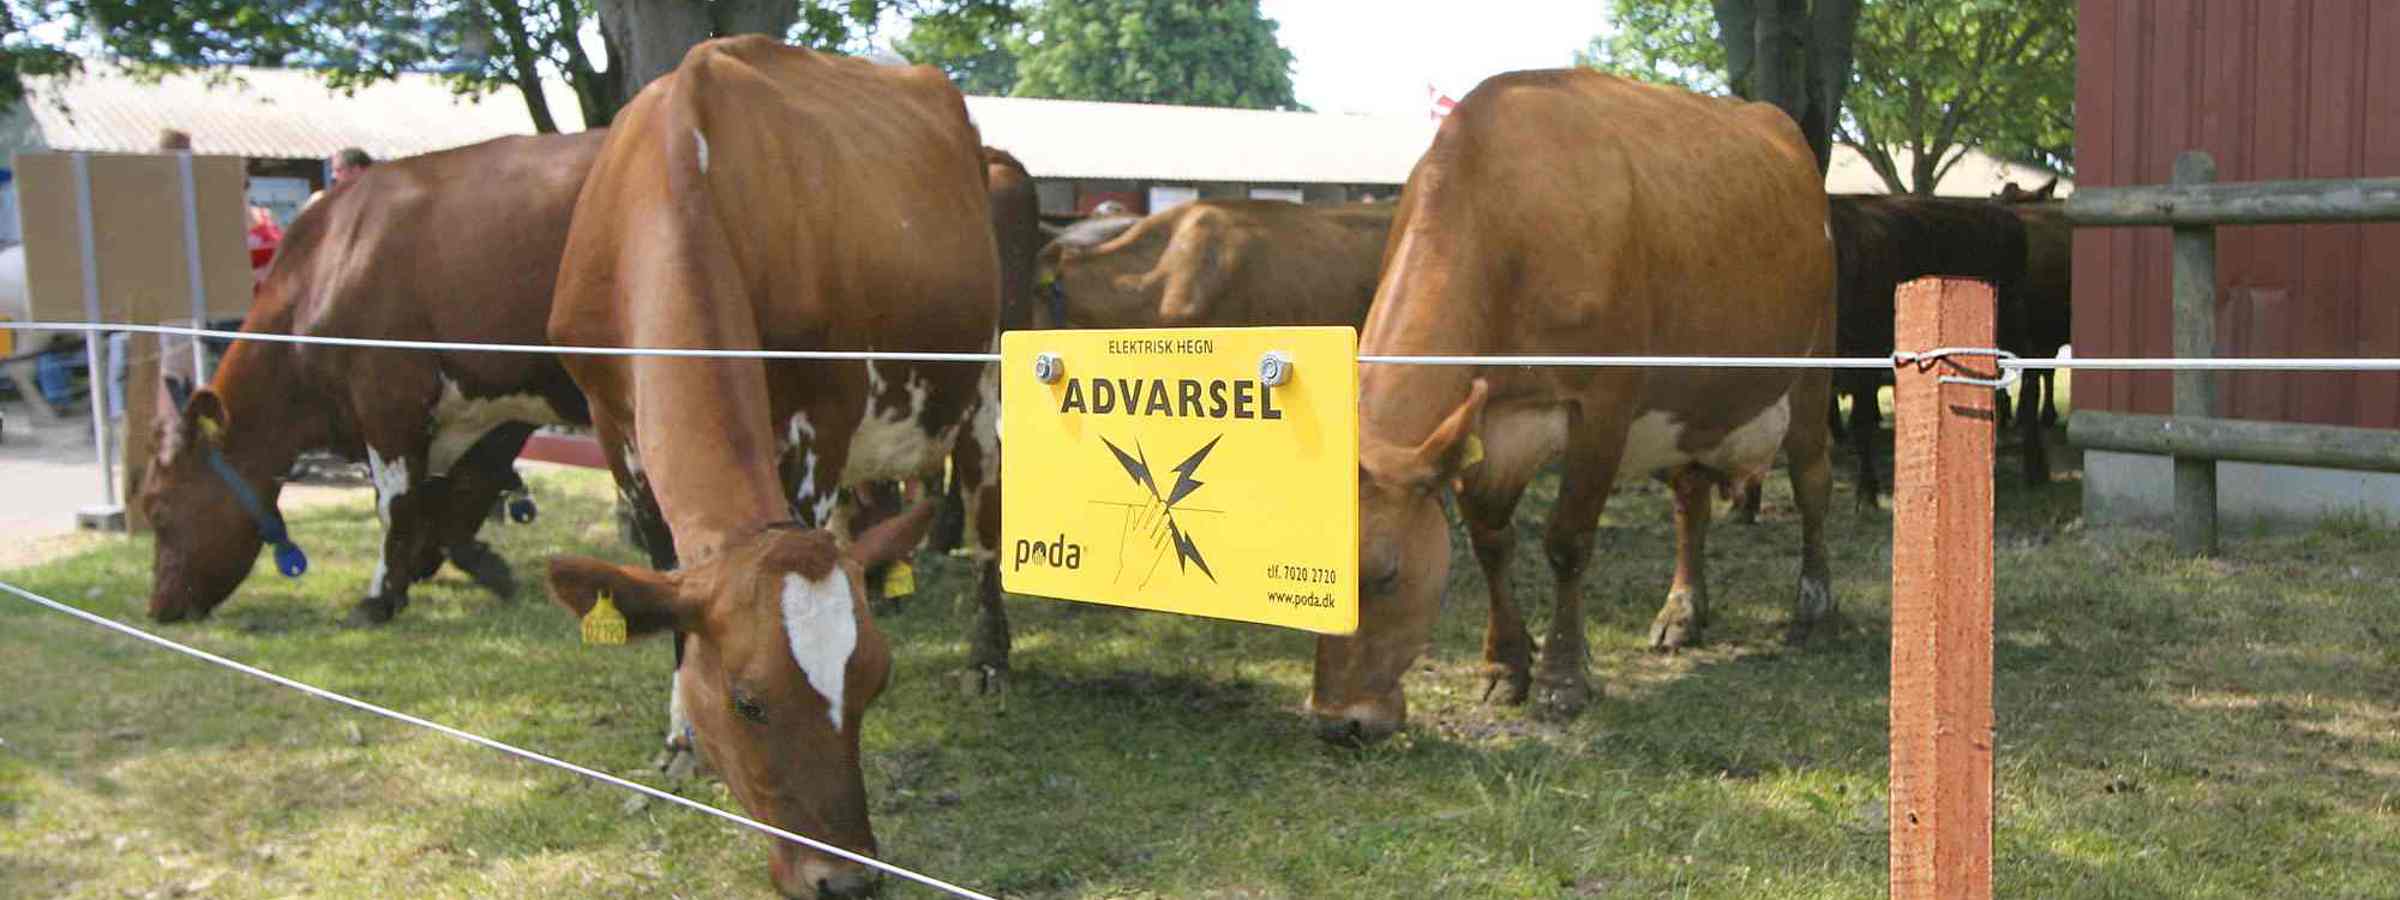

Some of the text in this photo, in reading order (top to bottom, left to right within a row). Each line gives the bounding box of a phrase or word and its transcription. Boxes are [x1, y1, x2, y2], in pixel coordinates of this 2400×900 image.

[1108, 339, 1214, 355] ELEKTRISK HEGN
[1060, 378, 1283, 420] ADVARSEL
[1014, 533, 1082, 572] poda
[1267, 564, 1337, 584] tlf. 7020 2720
[1267, 591, 1336, 608] www.poda.dk
